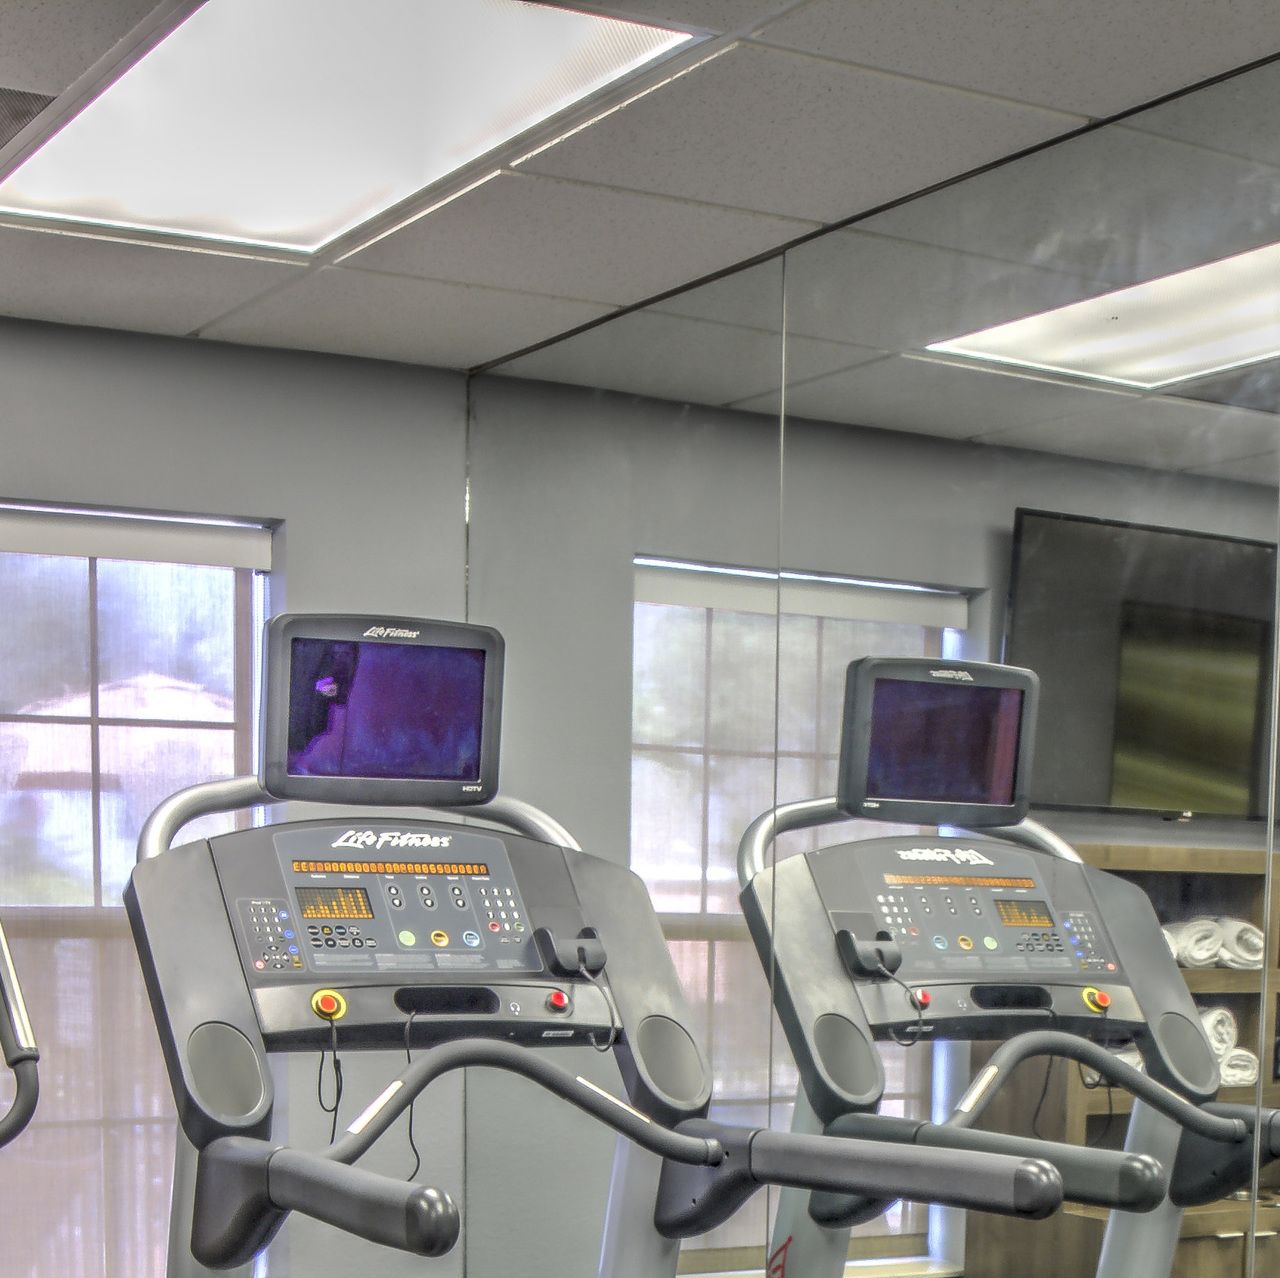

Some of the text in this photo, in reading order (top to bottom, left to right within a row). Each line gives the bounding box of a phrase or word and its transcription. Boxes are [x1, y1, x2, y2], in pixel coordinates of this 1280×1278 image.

[362, 626, 418, 638] Life Fitness
[330, 830, 451, 849] Life Fitness
